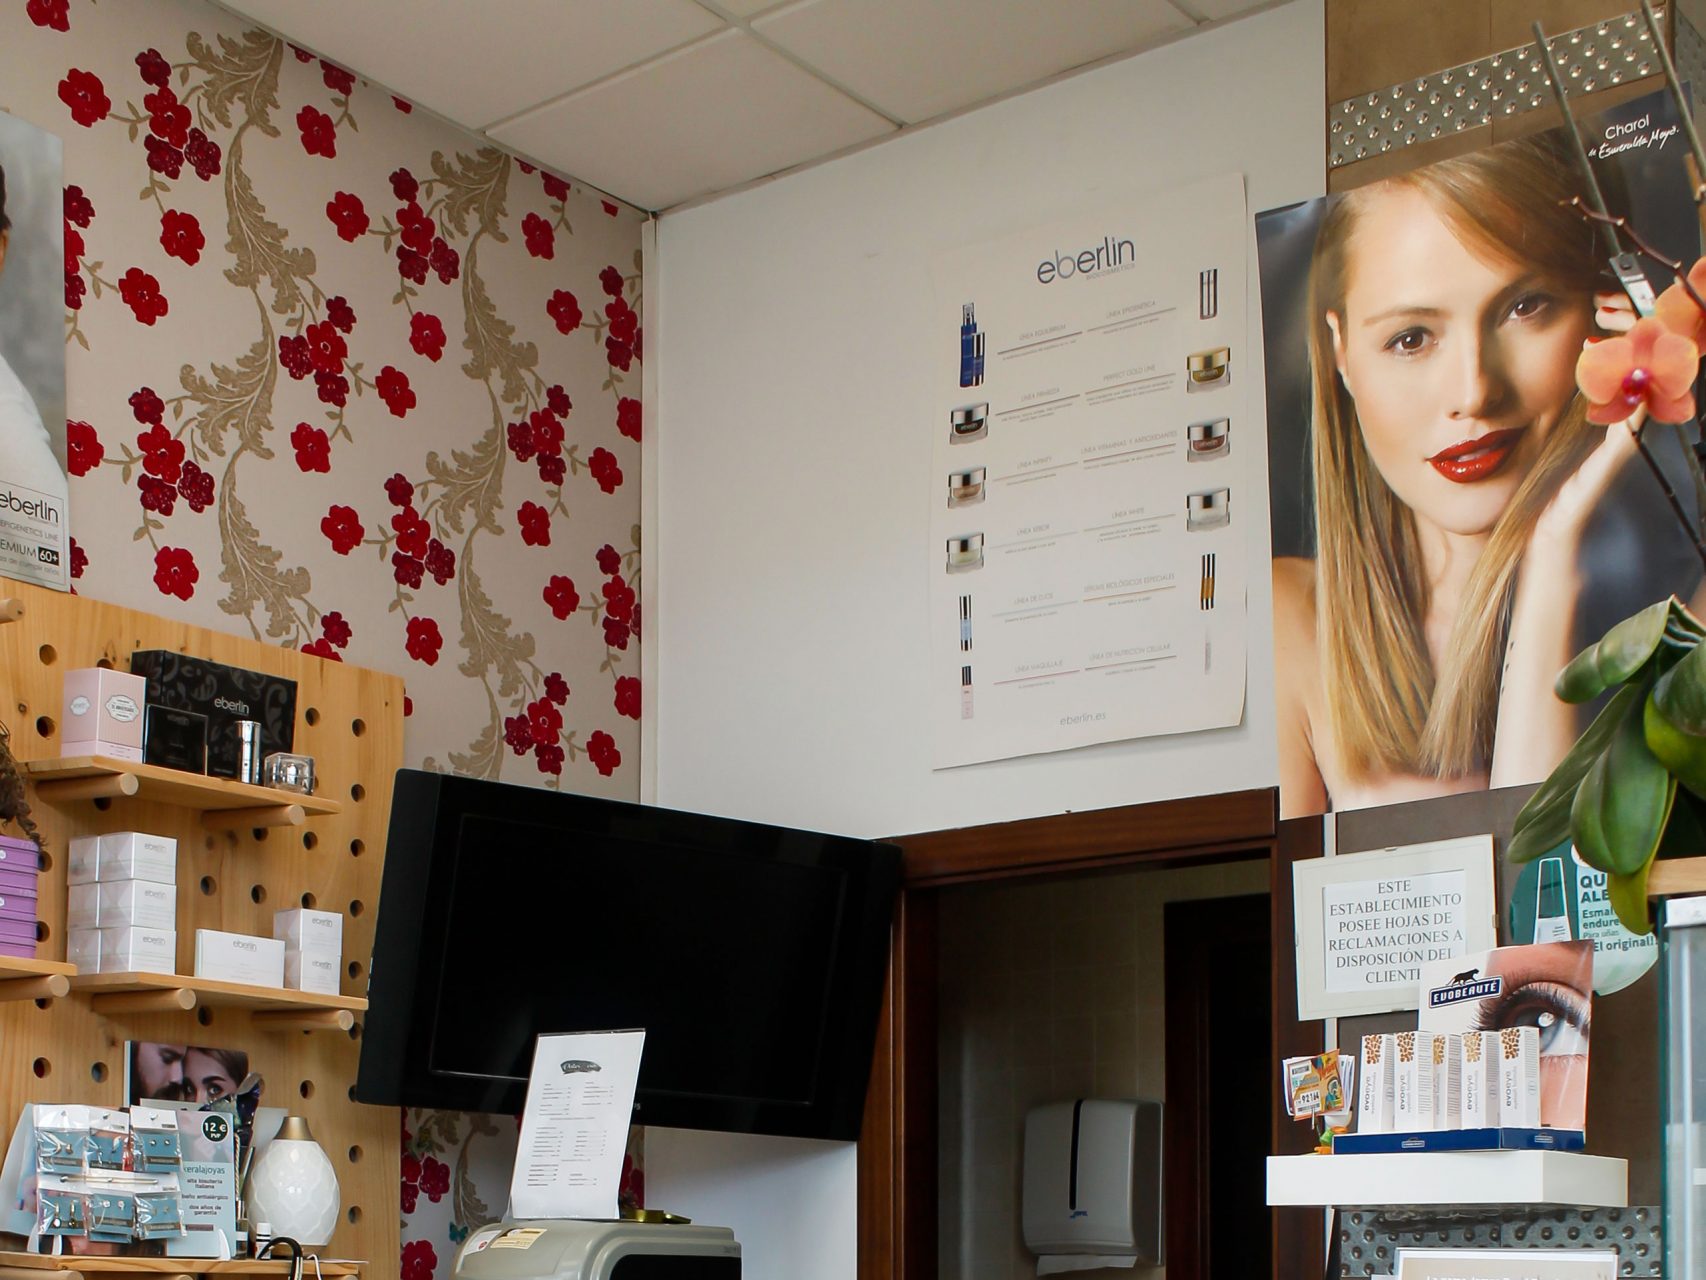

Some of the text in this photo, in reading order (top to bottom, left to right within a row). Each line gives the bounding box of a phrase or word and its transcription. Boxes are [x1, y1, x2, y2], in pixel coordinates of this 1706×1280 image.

[1605, 114, 1650, 140] Charol
[1599, 133, 1649, 159] Esmeralda
[1037, 236, 1135, 284] eberlin
[0, 491, 58, 523] eberlin
[39, 549, 58, 562] 60+
[214, 697, 250, 714] eberlin
[1059, 711, 1107, 726] eberlin.es
[1378, 880, 1411, 894] ESTE
[1330, 893, 1462, 916] ESTABLECIMIENTO
[1339, 912, 1453, 933] POSEE HOJAS DE
[1329, 929, 1463, 951] RECLAMACIONES A
[1336, 948, 1424, 968] DISPOSICIÓN
[205, 1122, 227, 1132] 12 €
